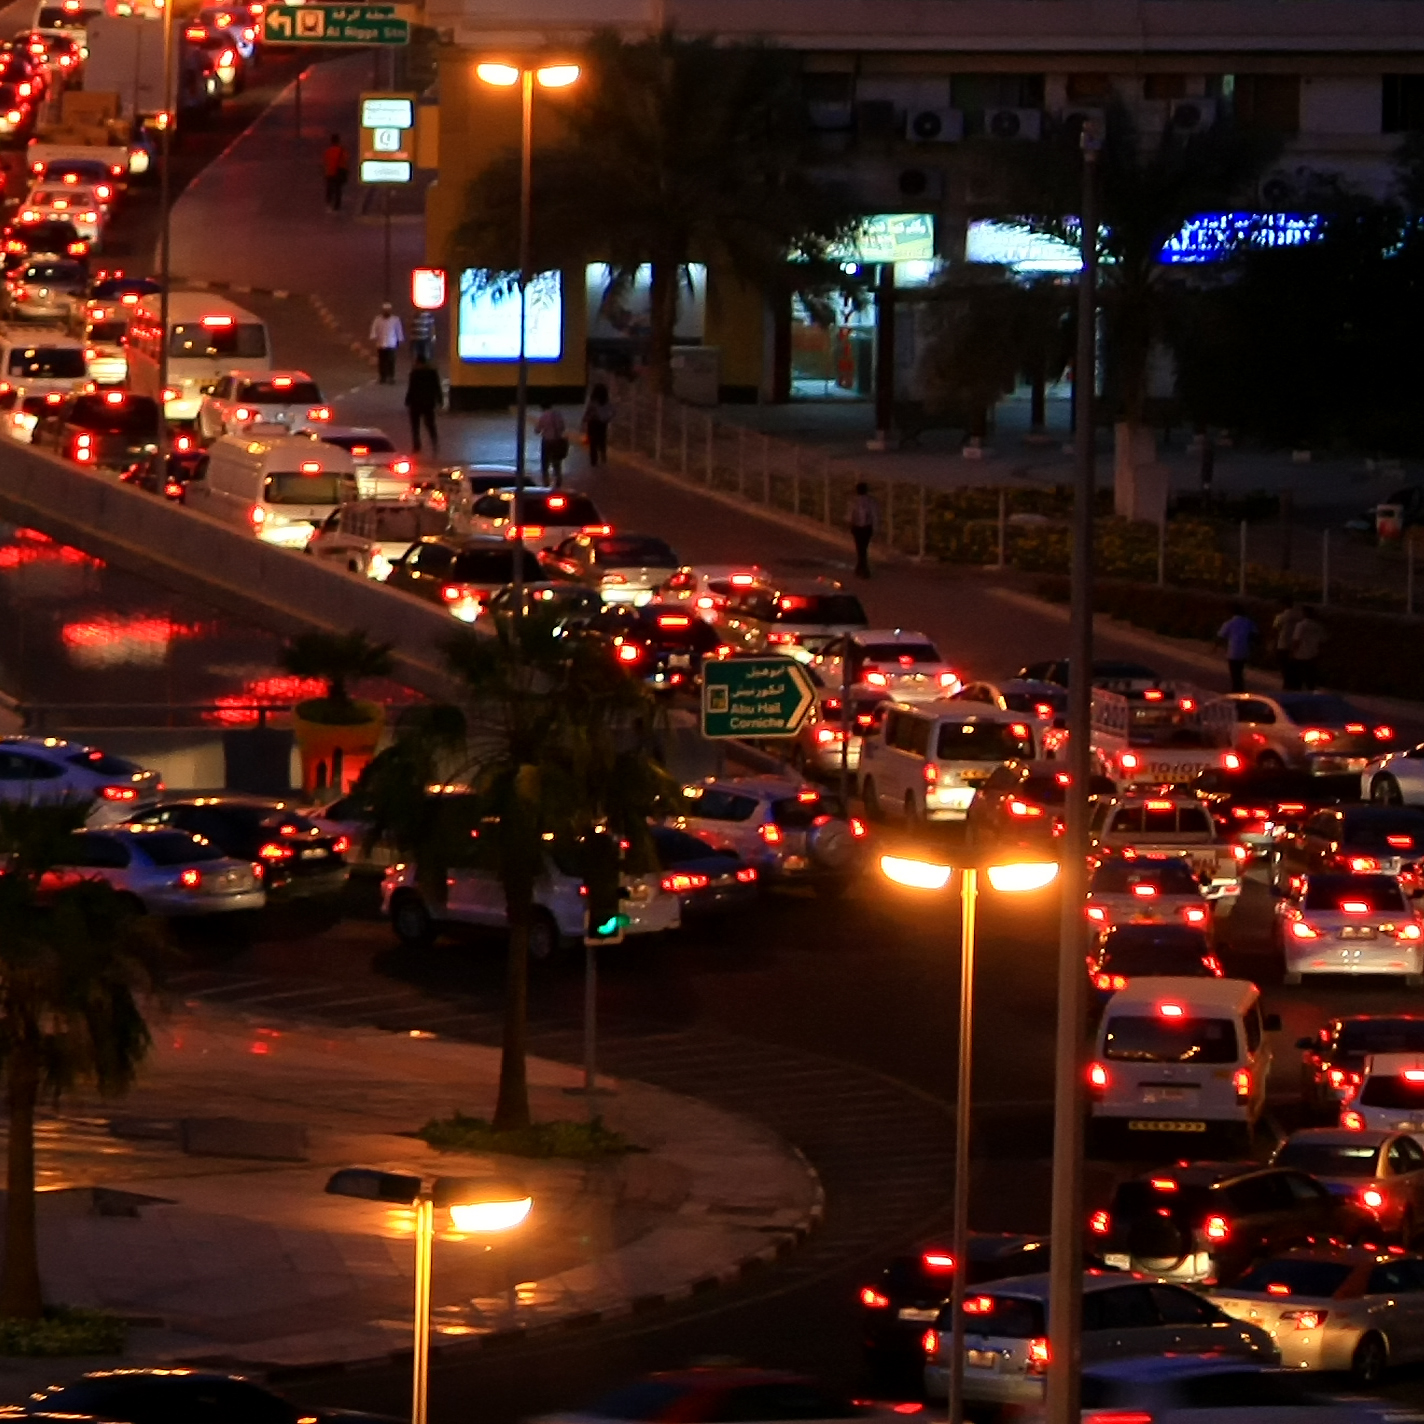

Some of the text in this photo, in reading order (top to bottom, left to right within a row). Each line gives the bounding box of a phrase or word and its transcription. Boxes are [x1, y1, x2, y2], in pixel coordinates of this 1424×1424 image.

[730, 701, 782, 715] Abu Hail
[729, 717, 786, 730] Corniche
